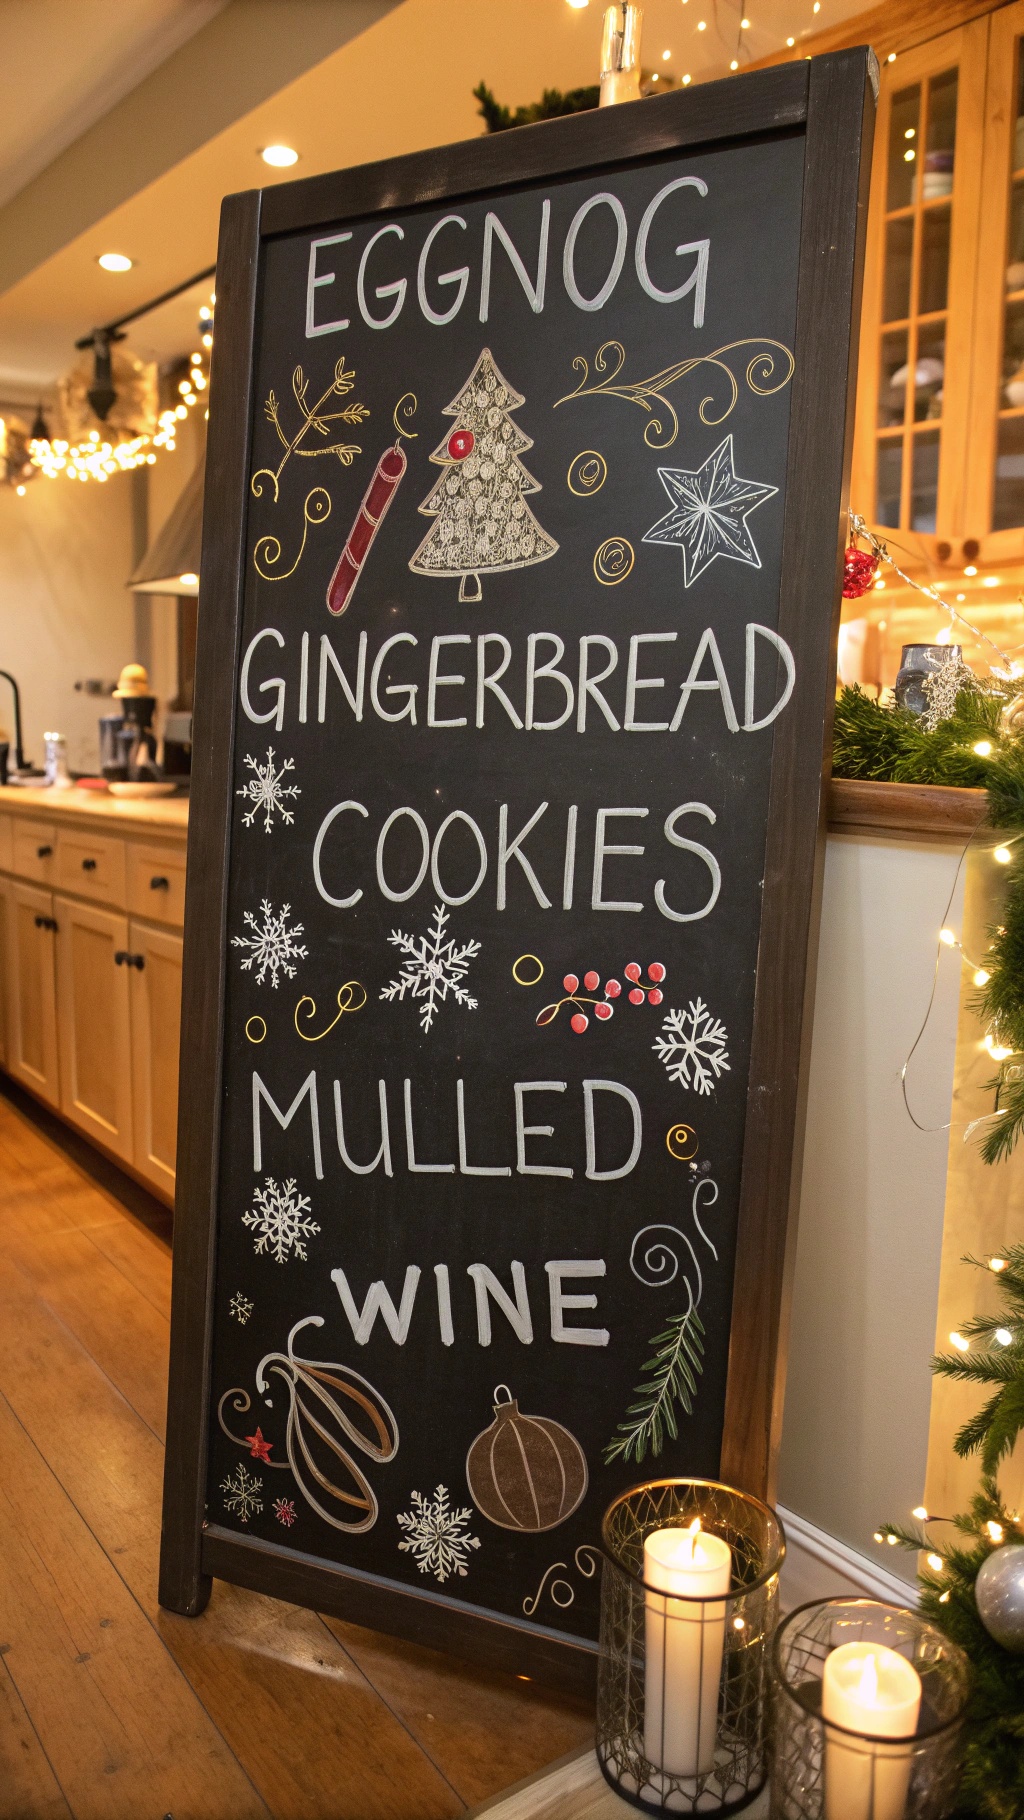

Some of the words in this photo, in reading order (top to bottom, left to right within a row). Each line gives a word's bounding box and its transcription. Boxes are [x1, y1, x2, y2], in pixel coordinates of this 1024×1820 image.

[304, 176, 711, 340] EGGNOG
[239, 622, 797, 734] GINGERBREAD
[312, 799, 723, 923] COOKIES
[252, 1070, 643, 1182] MULLED
[329, 1258, 611, 1347] WINE
